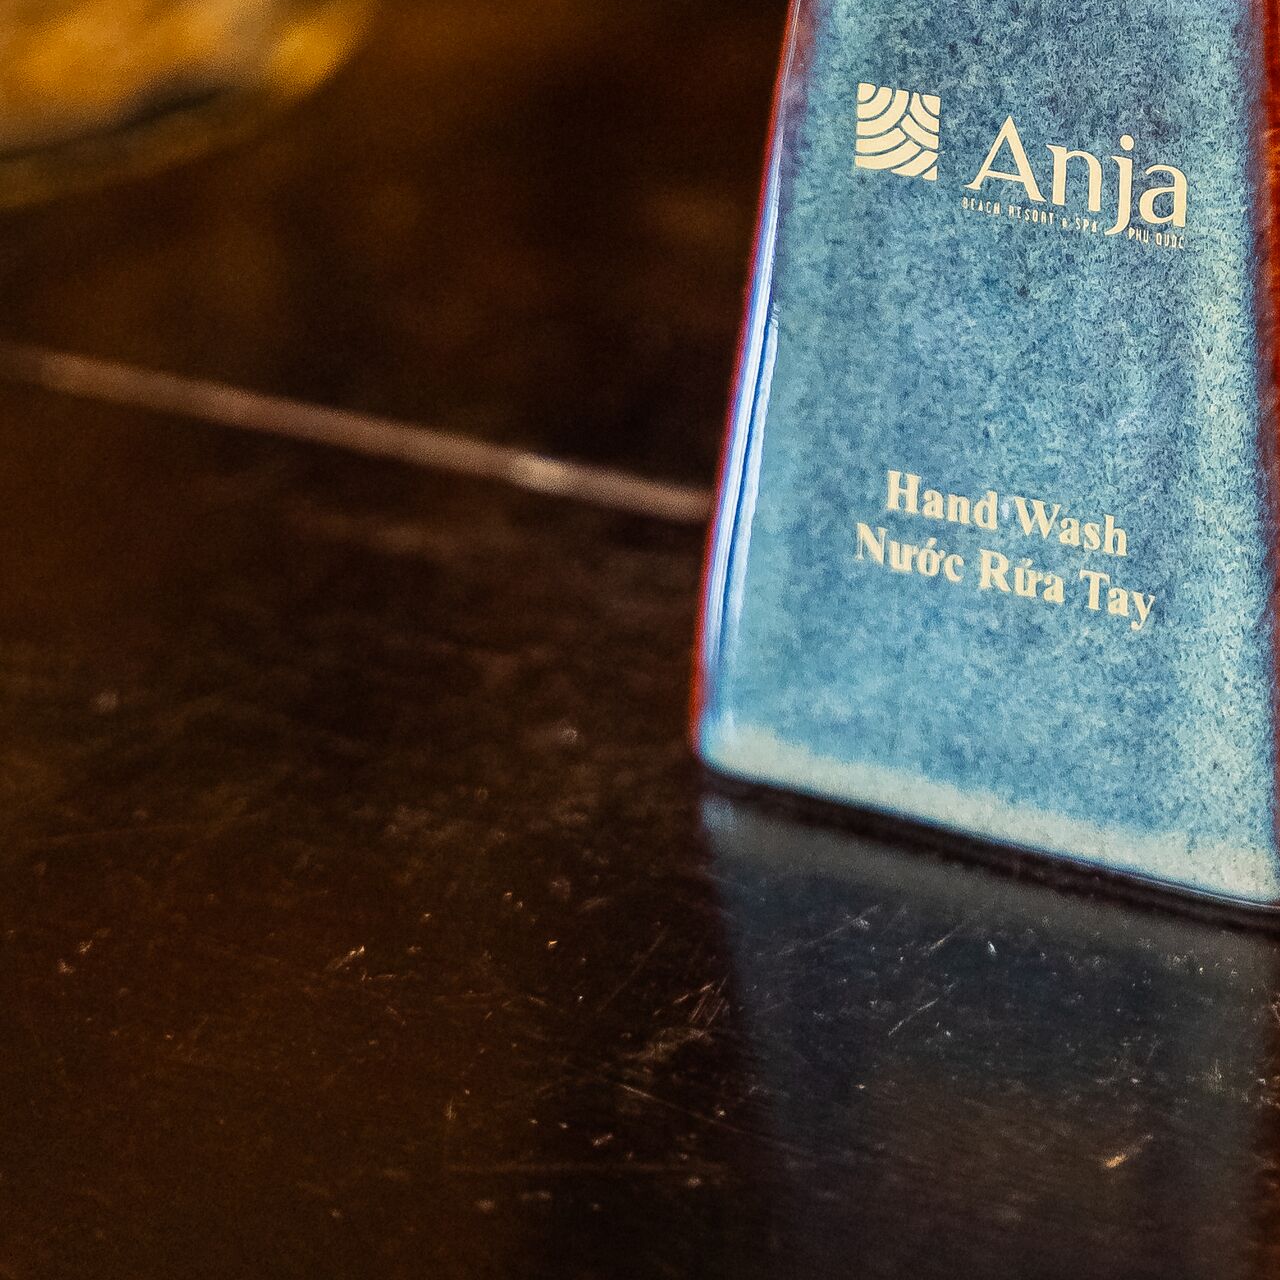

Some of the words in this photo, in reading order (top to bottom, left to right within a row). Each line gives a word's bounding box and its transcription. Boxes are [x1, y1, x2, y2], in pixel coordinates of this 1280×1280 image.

[961, 196, 1001, 215] BEACH
[1008, 204, 1054, 225] RESORT
[1075, 217, 1098, 233] SPA
[1128, 226, 1149, 243] PHU
[963, 115, 1188, 236] Anja
[887, 469, 998, 530] Hand
[1014, 496, 1128, 556] Wash
[855, 523, 965, 582] Nước
[1079, 569, 1155, 631] Tay
